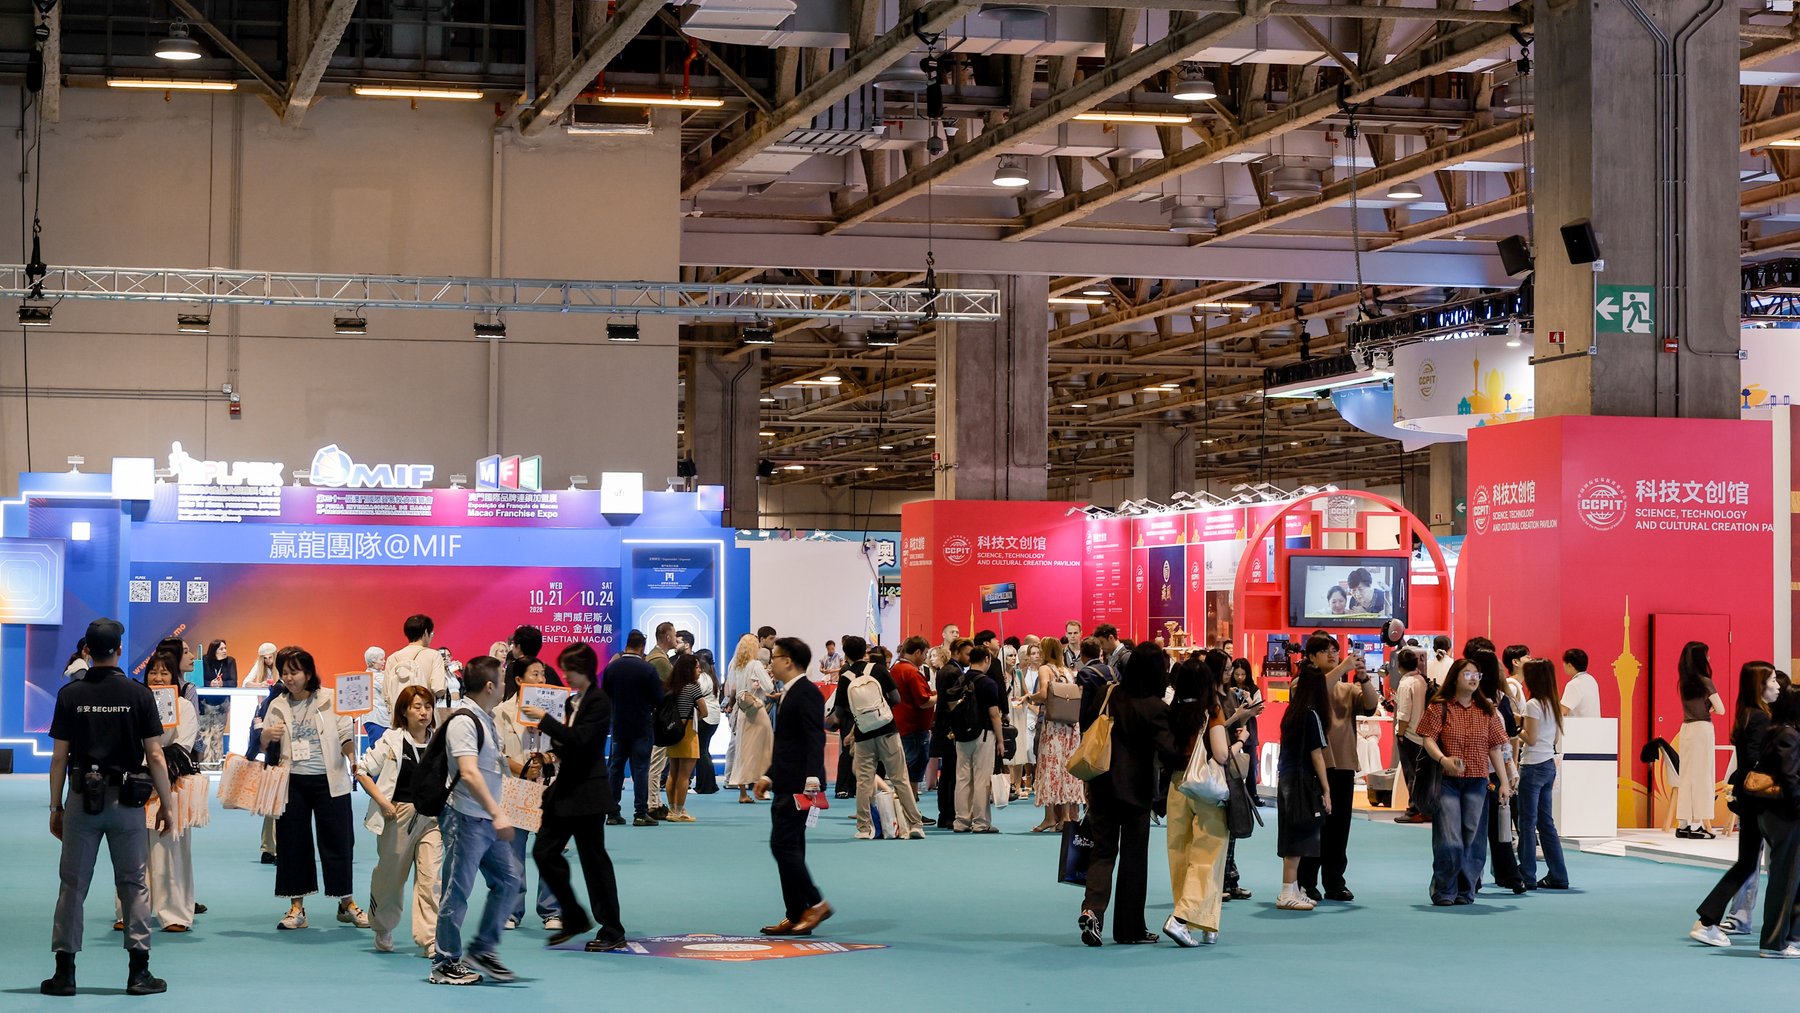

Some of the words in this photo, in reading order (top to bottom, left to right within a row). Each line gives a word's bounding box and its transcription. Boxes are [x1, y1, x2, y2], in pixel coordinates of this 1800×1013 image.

[350, 465, 433, 487] MIF
[1493, 480, 1536, 506] 科技文创馆
[1635, 479, 1749, 505] 科技文创馆
[1581, 499, 1623, 511] CCPIT
[467, 509, 494, 517] Macao
[495, 509, 536, 518] Franchise
[537, 509, 559, 519] Expo
[1473, 505, 1489, 516] CCPIT
[1635, 508, 1680, 520] SCIENCE,
[1681, 509, 1748, 519] TECHNOLOGY
[1635, 521, 1657, 530] AND
[1659, 521, 1709, 531] CULTURAL
[1711, 522, 1760, 531] CREATION
[977, 535, 1047, 551] 科技文创馆
[944, 547, 971, 555] CCPIT
[549, 582, 563, 590] WED
[601, 582, 613, 590] SAT
[529, 590, 562, 606] 10.21
[580, 590, 614, 606] 10.24
[553, 612, 612, 622] 澳門威尼斯人
[545, 625, 570, 633] EXPO,
[573, 624, 613, 634] 金光會展
[541, 635, 579, 643] ENETIAN
[581, 635, 613, 643] MACAO
[77, 705, 91, 713] 保安
[92, 705, 131, 713] SECURITY
